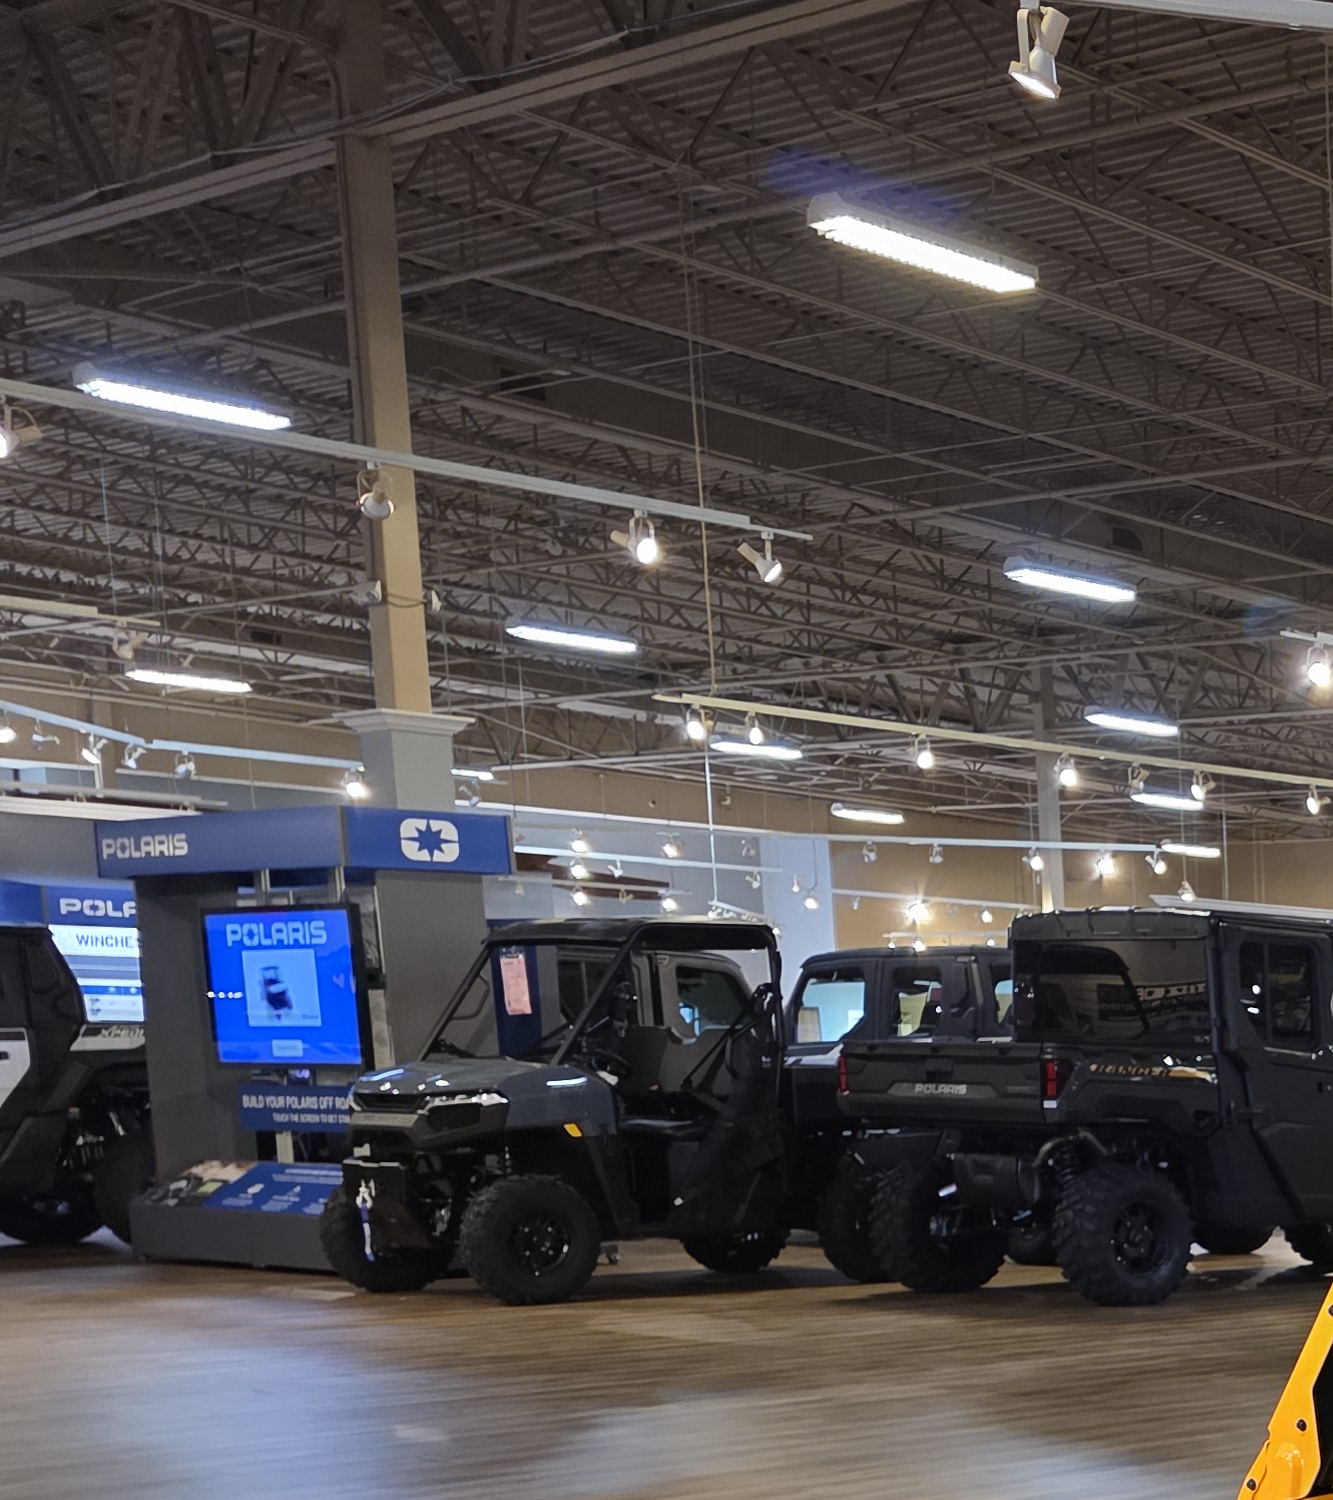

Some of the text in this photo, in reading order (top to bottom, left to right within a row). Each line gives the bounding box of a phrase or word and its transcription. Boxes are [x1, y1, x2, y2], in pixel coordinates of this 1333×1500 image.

[101, 833, 189, 860] POLARIS
[59, 898, 138, 918] POLA
[226, 920, 328, 948] POLARIS
[914, 1083, 968, 1096] POLARIS
[242, 1094, 265, 1109] BUILD
[265, 1095, 285, 1109] YOUR
[285, 1095, 318, 1110] POLARIS
[319, 1096, 334, 1110] OFF
